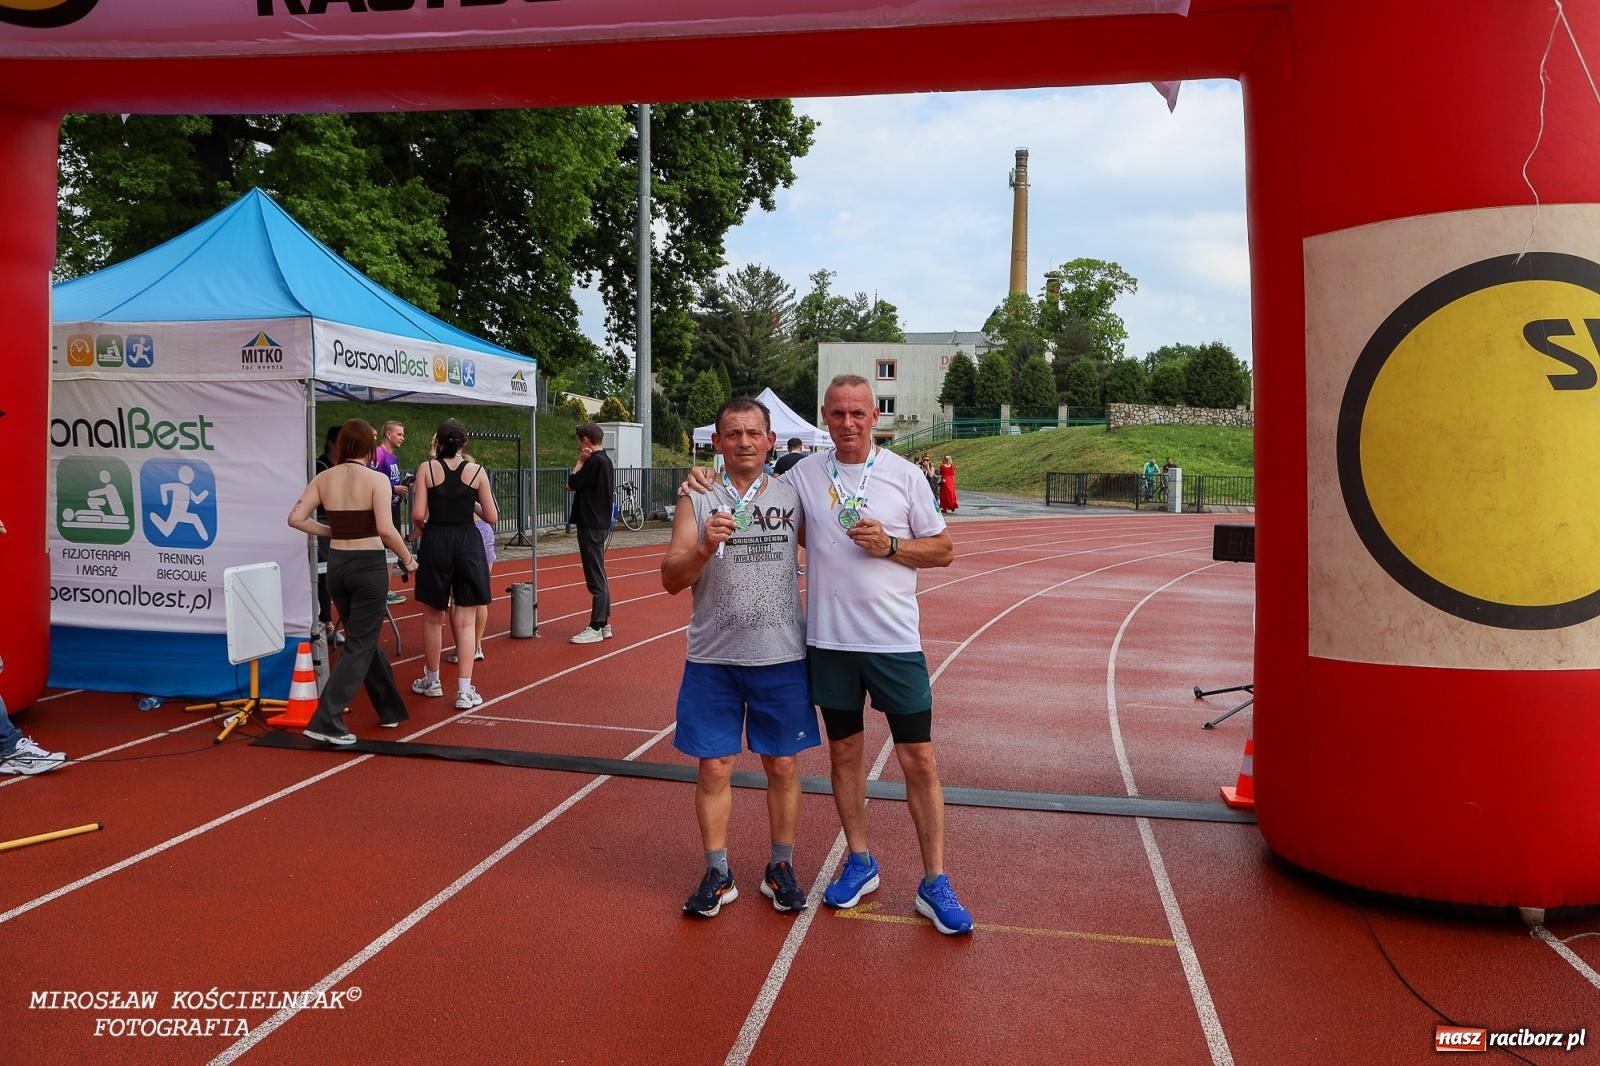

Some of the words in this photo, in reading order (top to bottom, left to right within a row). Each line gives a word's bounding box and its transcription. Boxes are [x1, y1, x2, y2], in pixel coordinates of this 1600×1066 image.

[241, 348, 283, 363] MITKO
[333, 338, 429, 378] PersonalBest
[1522, 318, 1600, 391] S
[62, 548, 131, 562] FIZJOTERAPIA
[158, 552, 204, 566] TRENINGI
[76, 565, 79, 575] I
[82, 564, 118, 577] MASAŻ
[157, 569, 206, 582] BIEGOWE
